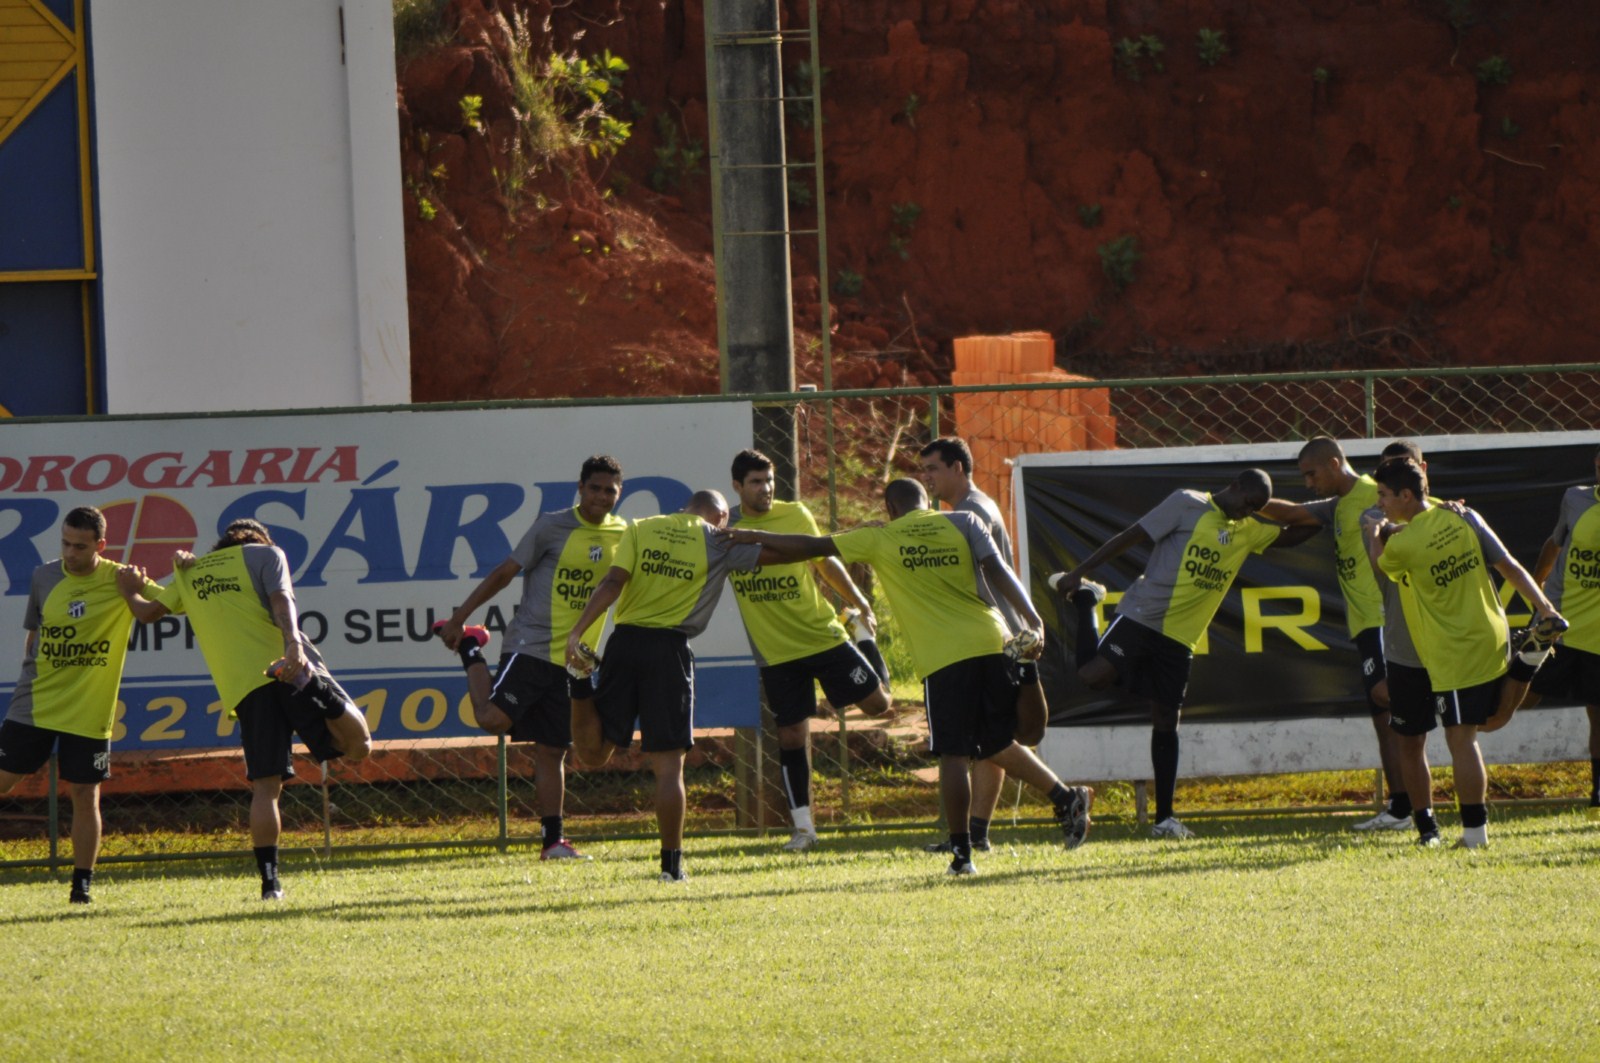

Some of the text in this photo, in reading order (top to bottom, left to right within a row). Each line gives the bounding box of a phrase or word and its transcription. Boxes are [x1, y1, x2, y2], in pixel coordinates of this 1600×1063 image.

[642, 548, 671, 562] neo
[899, 545, 928, 556] neo
[1188, 544, 1221, 563] neo
[641, 561, 694, 581] química
[903, 554, 959, 571] química
[1430, 555, 1457, 576] neo
[1435, 556, 1480, 588] química
[192, 574, 214, 590] neo
[558, 567, 594, 582] neo
[557, 582, 597, 601] quím
[734, 576, 799, 597] química
[41, 625, 77, 639] neo
[343, 608, 435, 645] SEU
[41, 639, 111, 660] química
